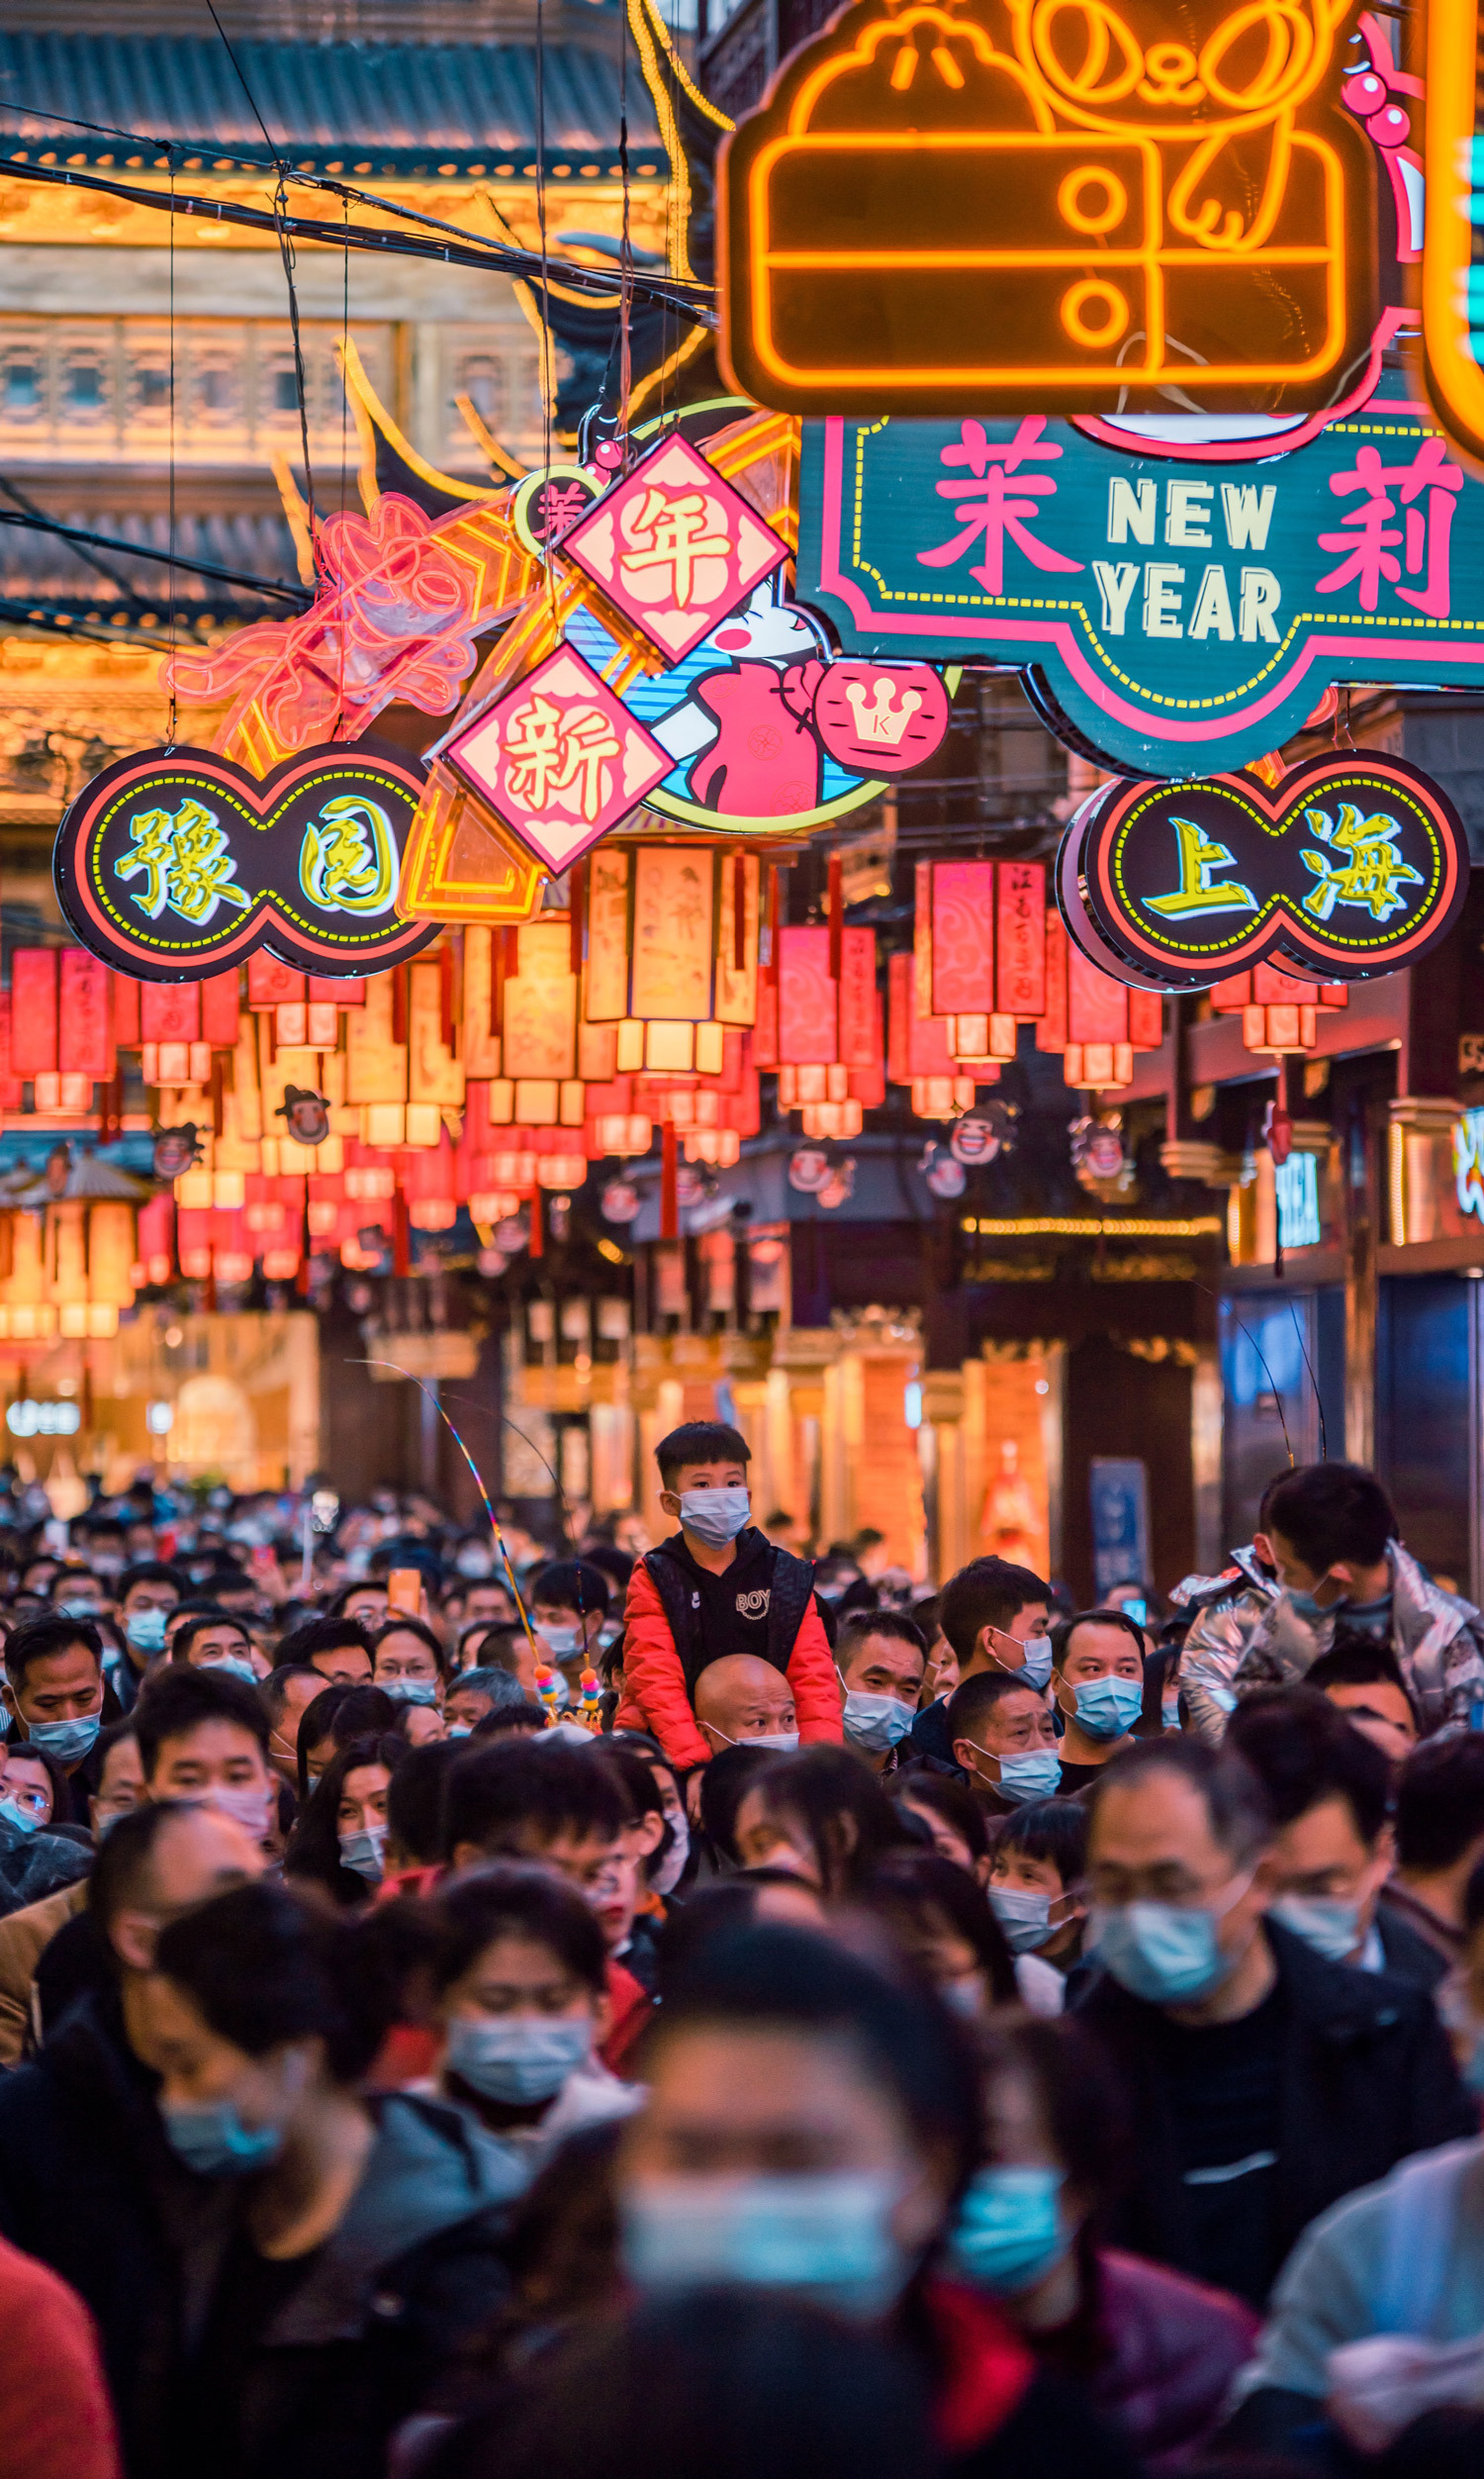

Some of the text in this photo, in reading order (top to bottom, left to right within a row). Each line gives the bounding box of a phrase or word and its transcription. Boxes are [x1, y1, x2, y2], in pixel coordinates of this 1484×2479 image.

[618, 485, 734, 610] 年
[916, 415, 1464, 619] 茉 莉
[1107, 476, 1277, 550] NEW
[1091, 560, 1282, 643] YEAR
[500, 694, 624, 824] 新
[872, 714, 891, 736] K
[1141, 802, 1426, 923] 上海
[735, 1588, 772, 1612] BOY
